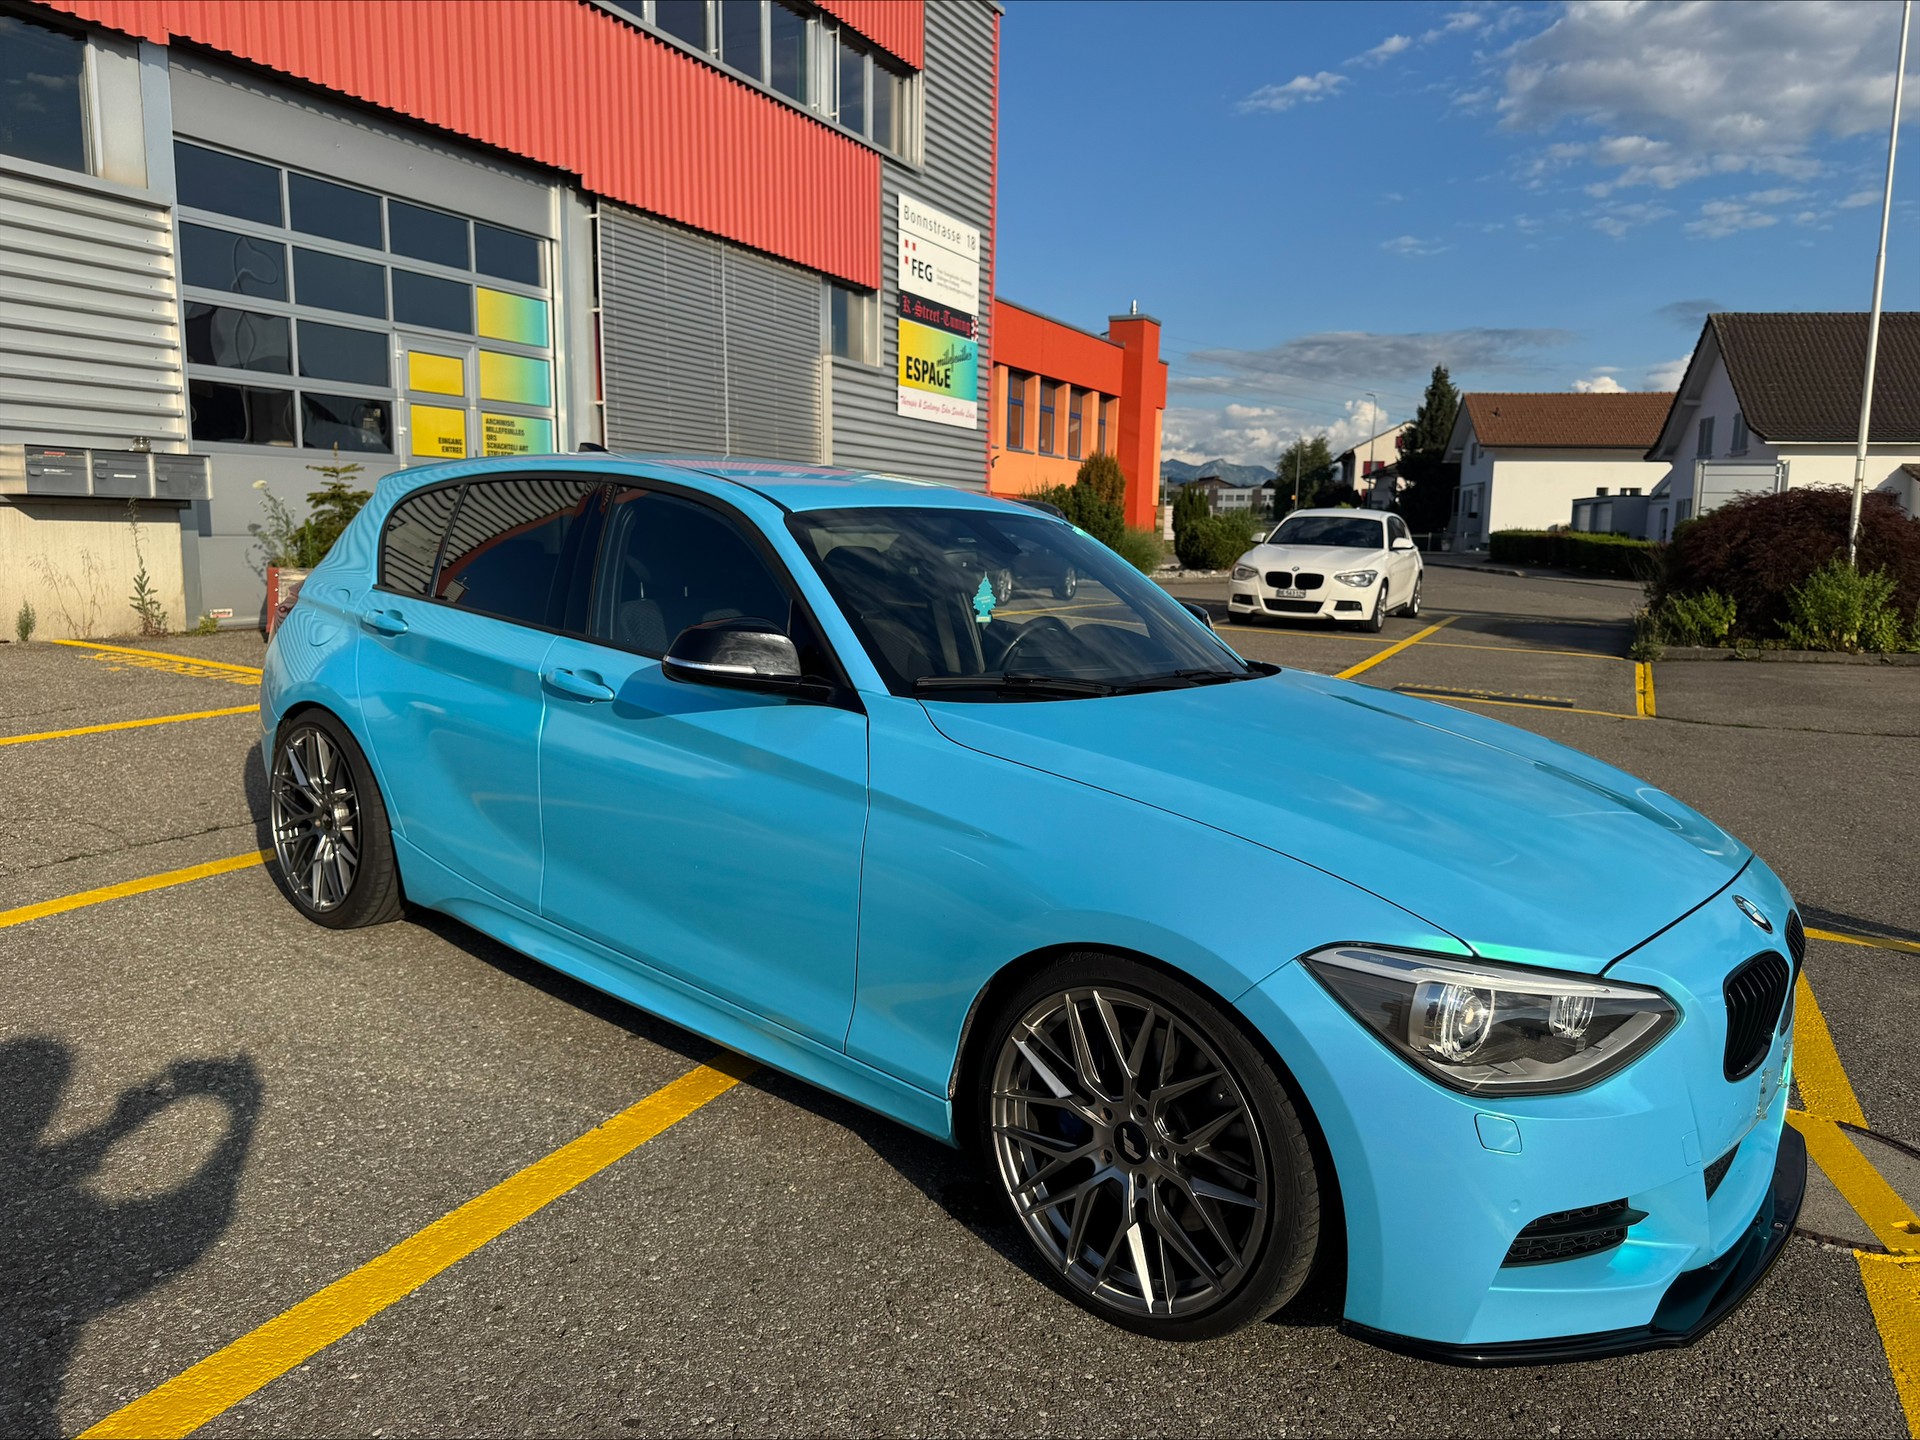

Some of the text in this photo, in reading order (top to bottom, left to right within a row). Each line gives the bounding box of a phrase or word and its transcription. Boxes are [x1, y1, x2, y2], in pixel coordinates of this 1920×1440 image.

[904, 204, 977, 251] Bonnstrasse 18
[912, 258, 933, 283] FEG
[905, 355, 951, 389] ESPACE
[438, 437, 463, 445] EINGANG
